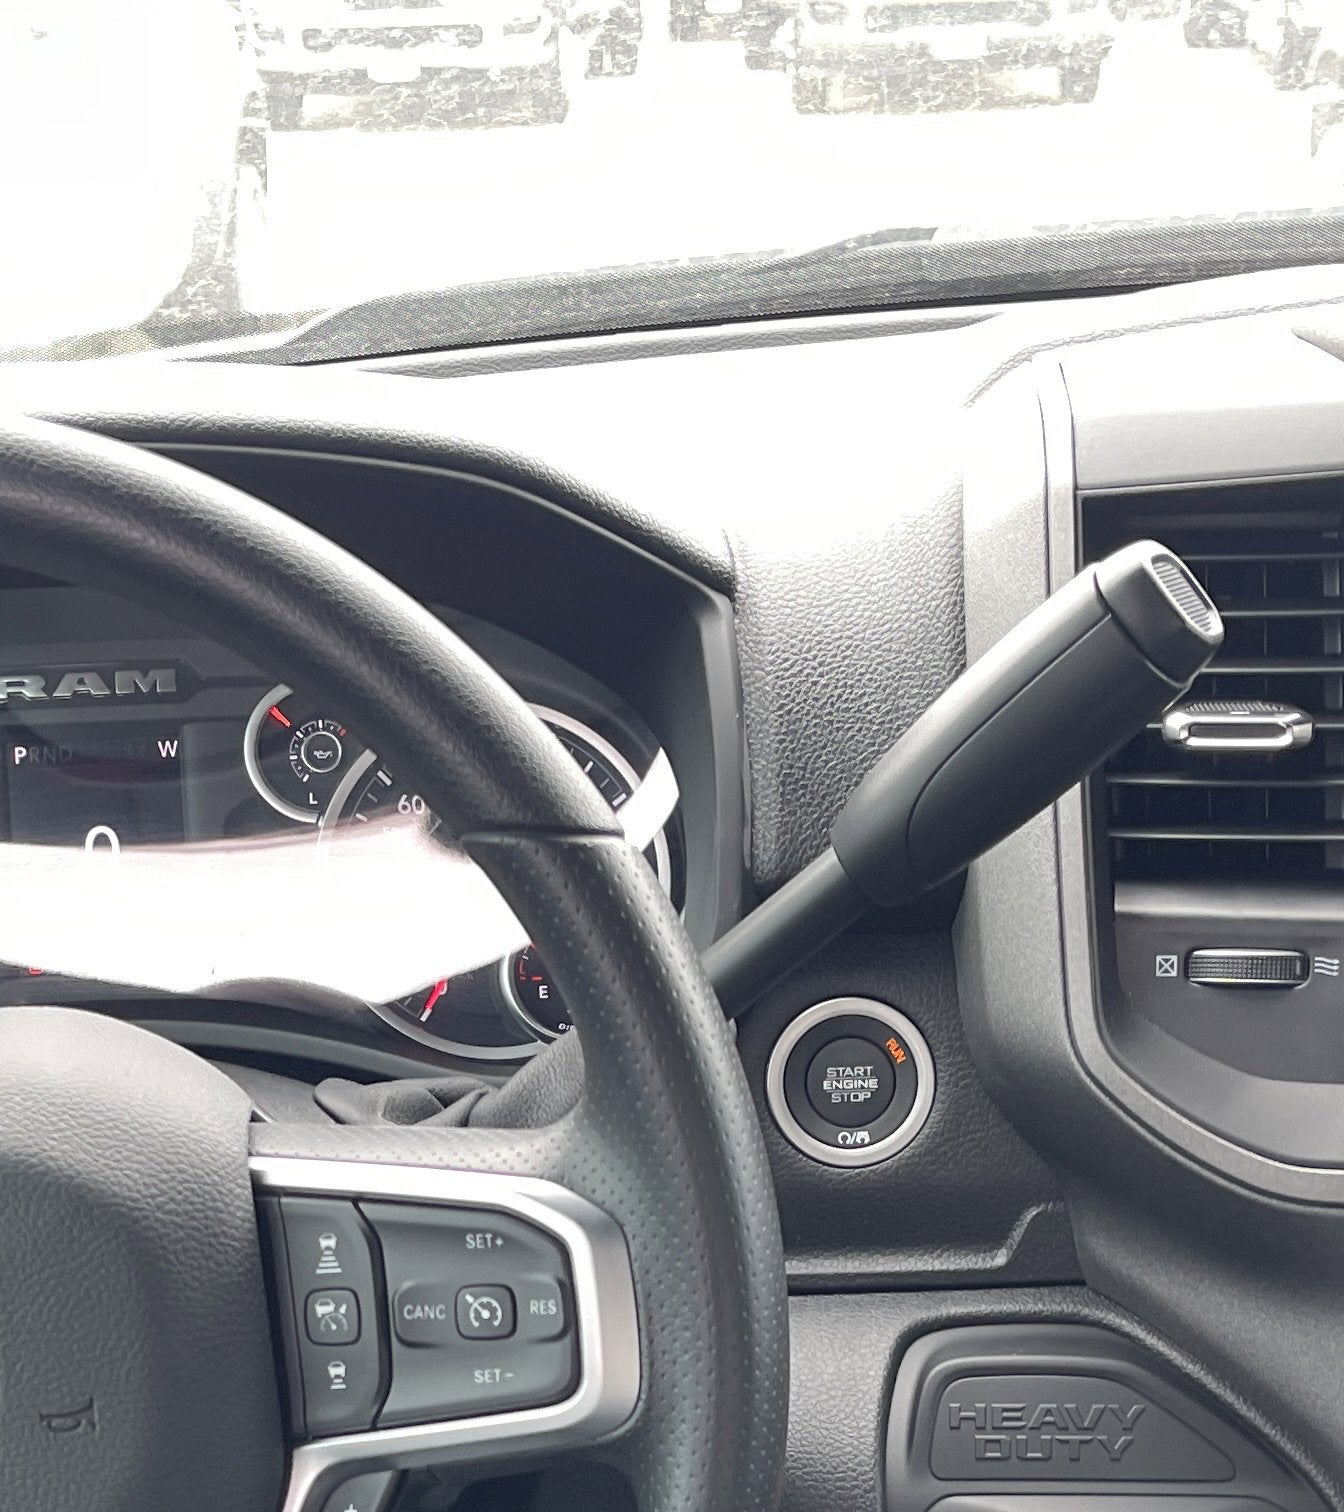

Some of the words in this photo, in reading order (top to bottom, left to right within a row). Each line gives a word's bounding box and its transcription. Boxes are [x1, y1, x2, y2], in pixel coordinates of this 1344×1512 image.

[157, 739, 178, 758] W
[308, 792, 318, 805] L
[397, 794, 425, 815] 60
[538, 985, 549, 999] E
[885, 1037, 907, 1065] RUN
[826, 1066, 874, 1078] START
[823, 1078, 879, 1091] ENGINE
[831, 1091, 872, 1104] STOP
[403, 1303, 446, 1322] CANC
[529, 1298, 557, 1315] RES
[948, 1403, 1146, 1431] HEAVY
[974, 1434, 1135, 1461] DUTY
